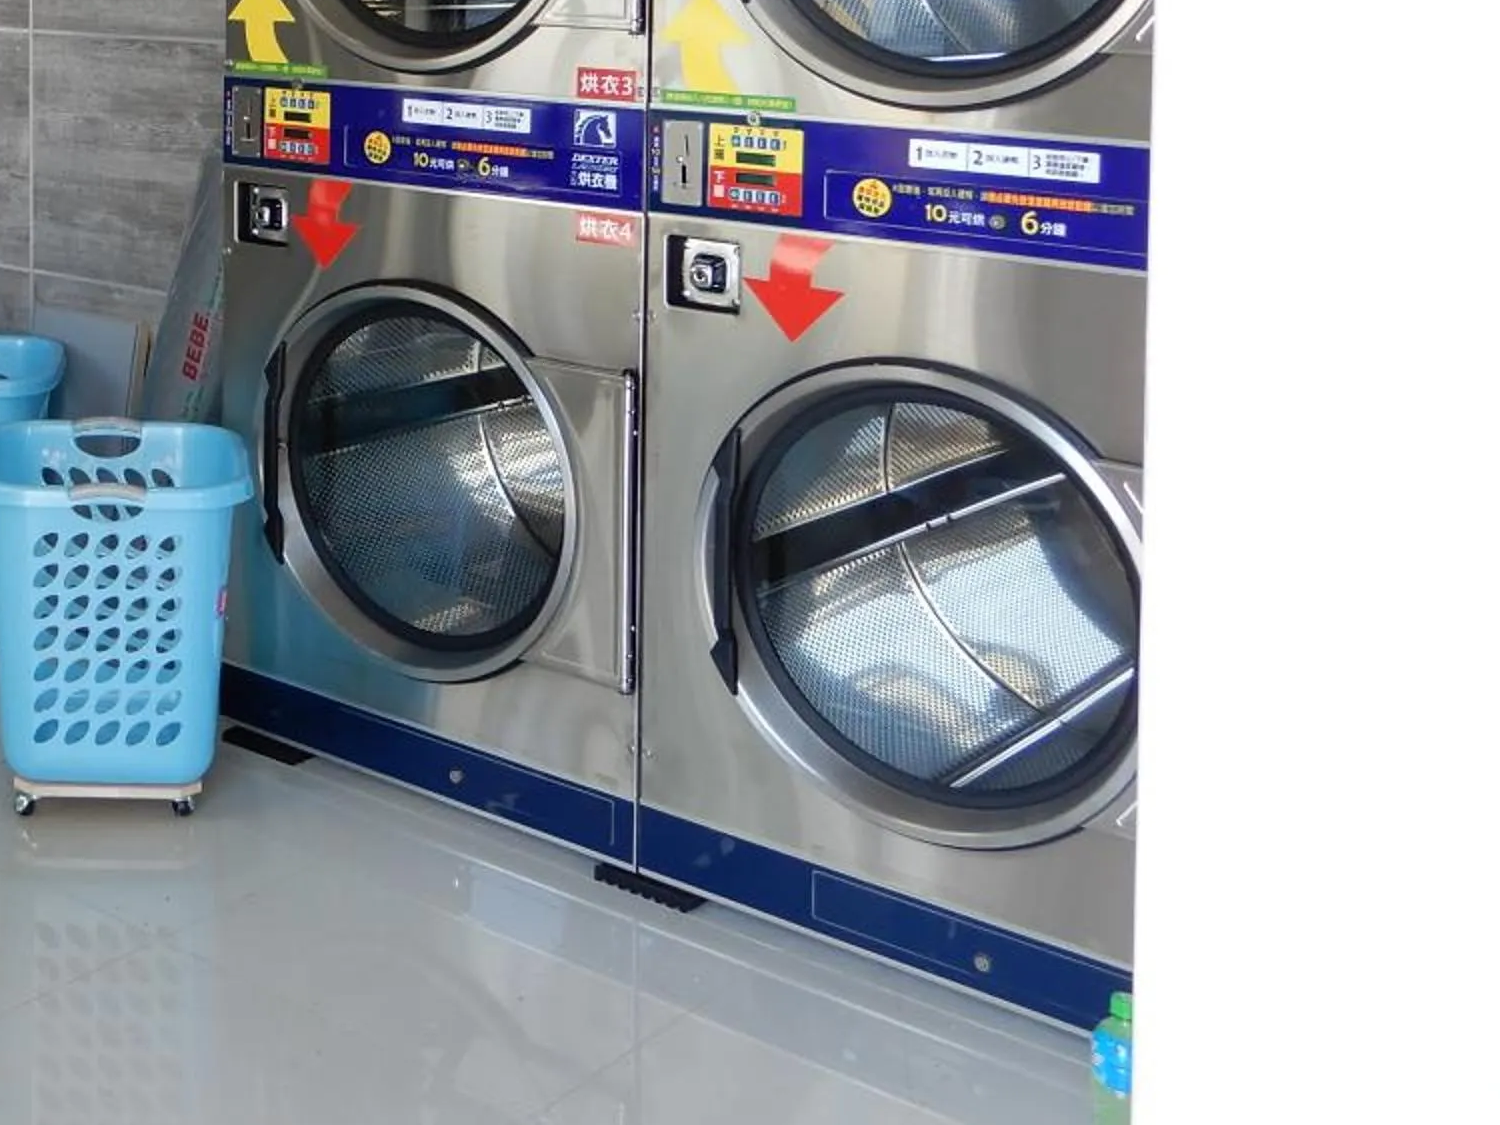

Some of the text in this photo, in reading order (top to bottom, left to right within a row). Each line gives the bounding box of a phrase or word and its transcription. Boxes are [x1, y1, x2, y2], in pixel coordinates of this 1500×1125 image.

[580, 72, 634, 98] 烘衣3
[916, 146, 923, 161] 1
[973, 150, 983, 166] 2
[1032, 155, 1041, 170] 3
[579, 217, 632, 244] 烘衣4
[182, 312, 209, 381] BEBE
